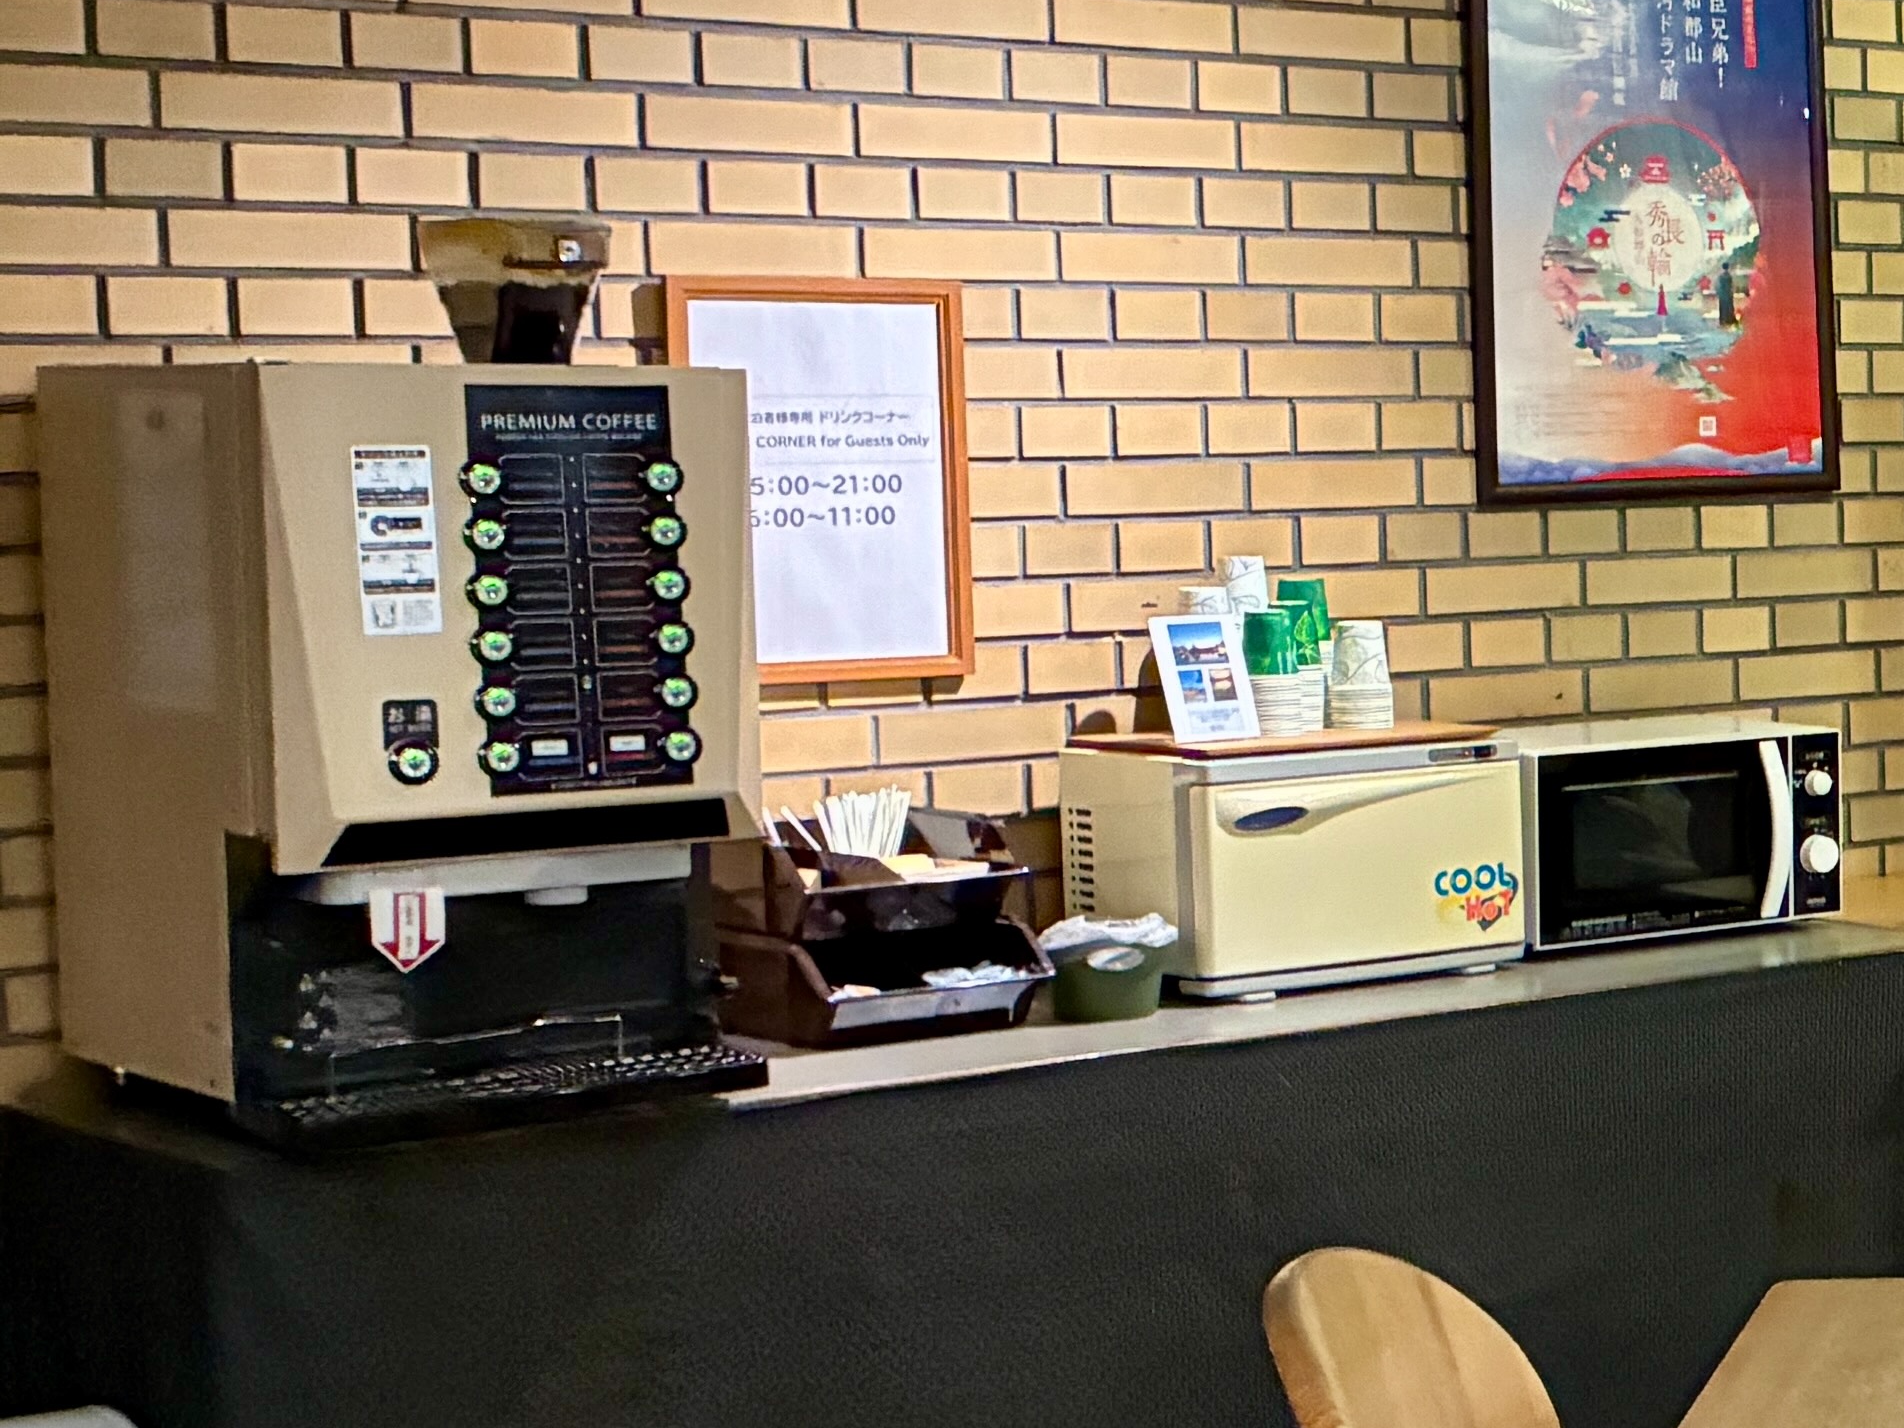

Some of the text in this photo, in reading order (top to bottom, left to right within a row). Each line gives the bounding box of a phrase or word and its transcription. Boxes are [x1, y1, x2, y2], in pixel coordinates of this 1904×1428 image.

[479, 413, 657, 431] PREMIUM COFFEE
[756, 434, 930, 448] CORNER for Guests Only
[1434, 862, 1512, 897] COOL
